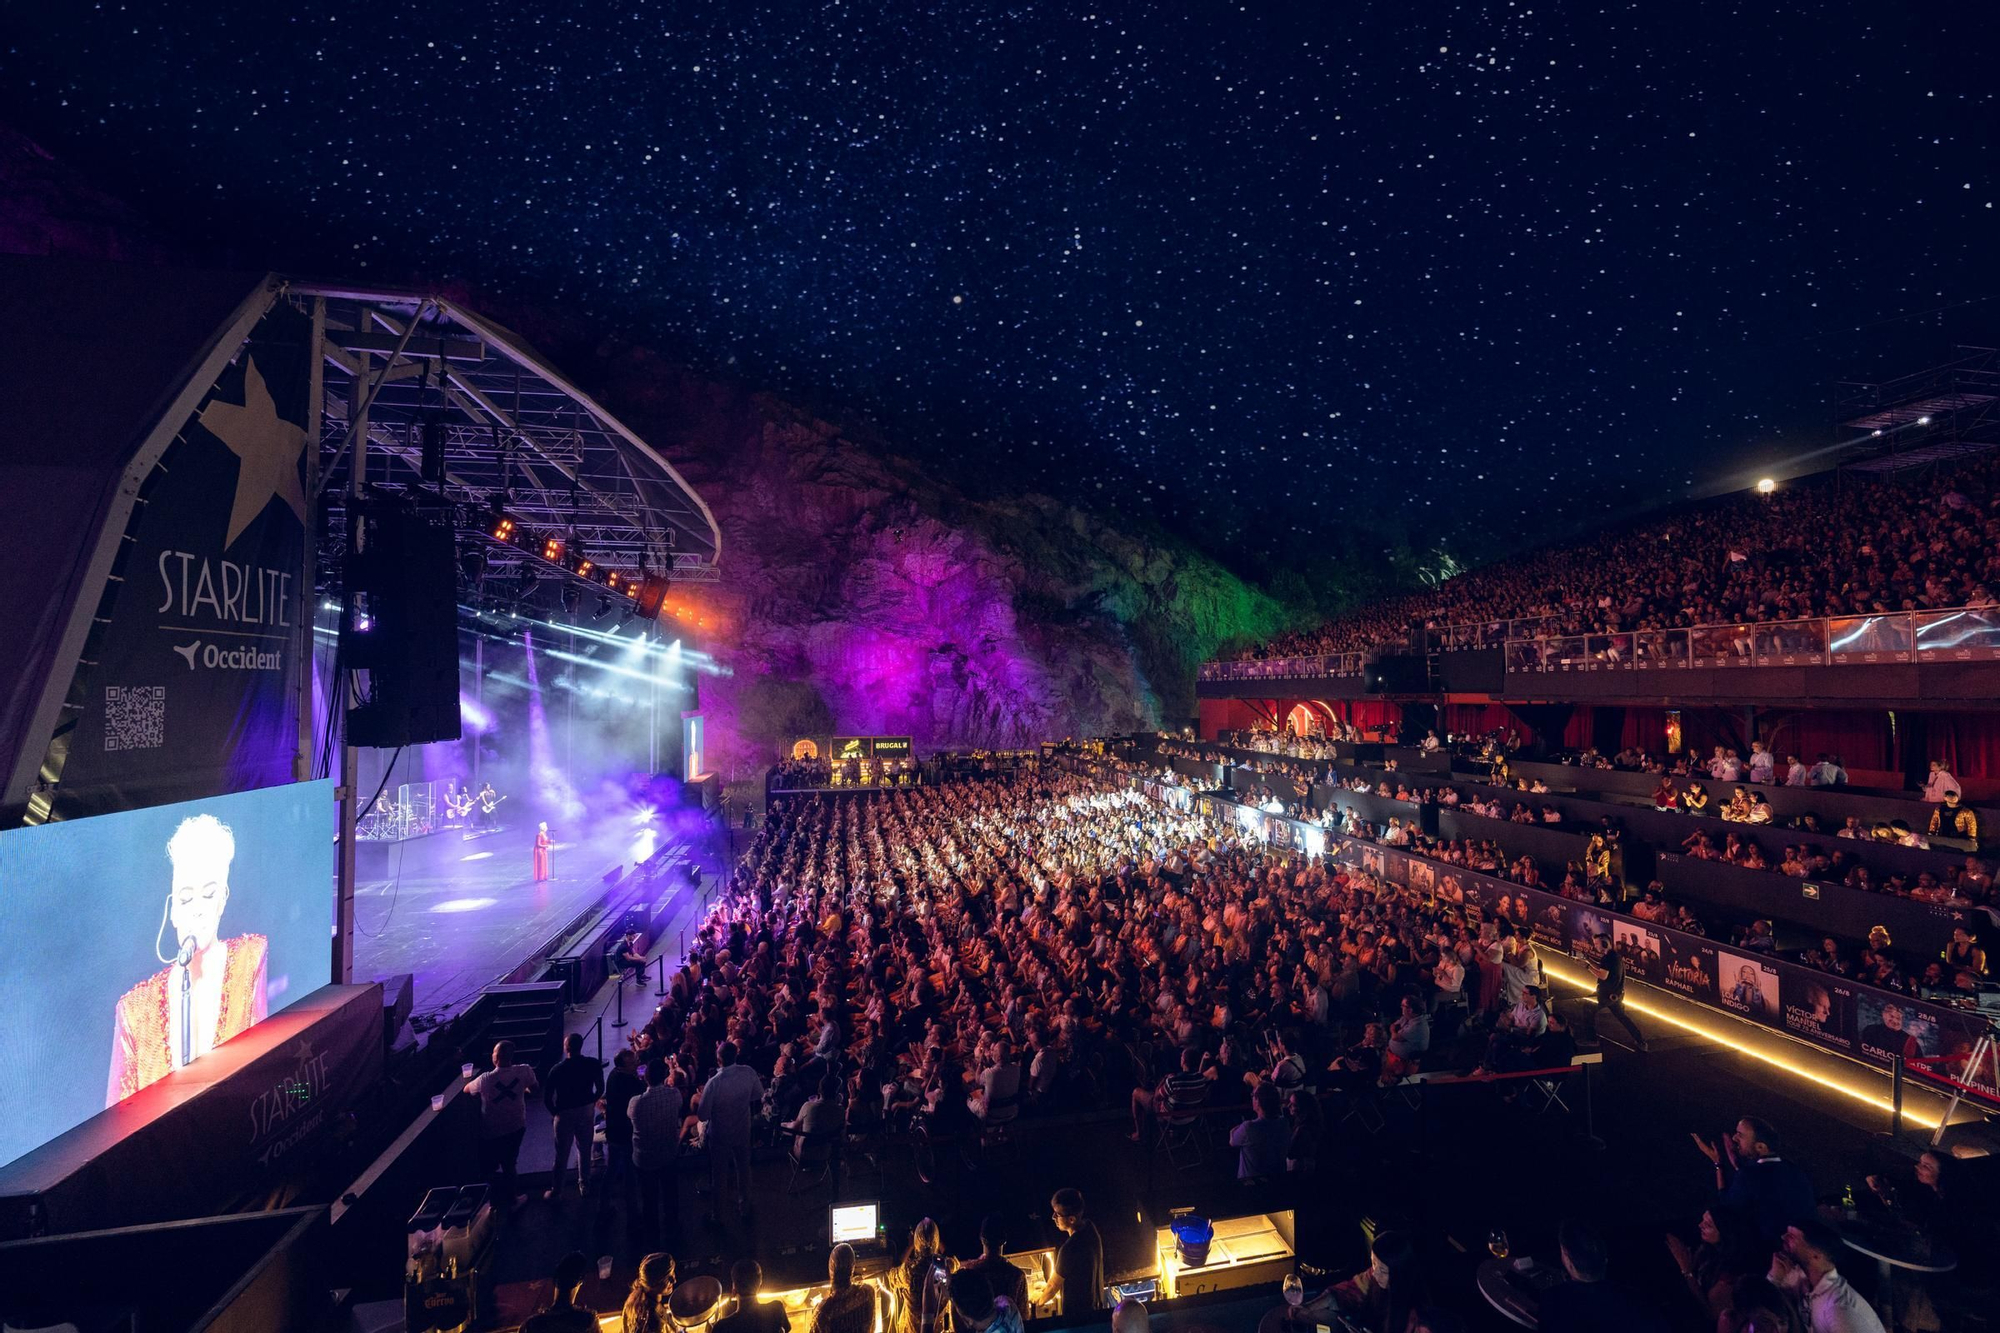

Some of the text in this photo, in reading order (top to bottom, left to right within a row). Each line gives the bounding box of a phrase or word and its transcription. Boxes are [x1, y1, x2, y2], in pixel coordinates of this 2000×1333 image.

[158, 550, 292, 627] STARLITE
[203, 644, 281, 670] Occident
[875, 742, 903, 750] BRUGAL
[1701, 947, 1713, 955] 24/8
[1763, 966, 1777, 974] 25/8
[1665, 977, 1694, 993] RAPHAEL
[1834, 987, 1851, 997] 26/8
[1721, 991, 1740, 1002] LOLA
[1721, 997, 1750, 1013] INDIGO
[1786, 1004, 1818, 1021] VÍCTOR
[1786, 1013, 1821, 1031] MANUEL
[1917, 1012, 1937, 1023] 28/8
[249, 1049, 331, 1145] STARLITE
[273, 1109, 324, 1158] Occident
